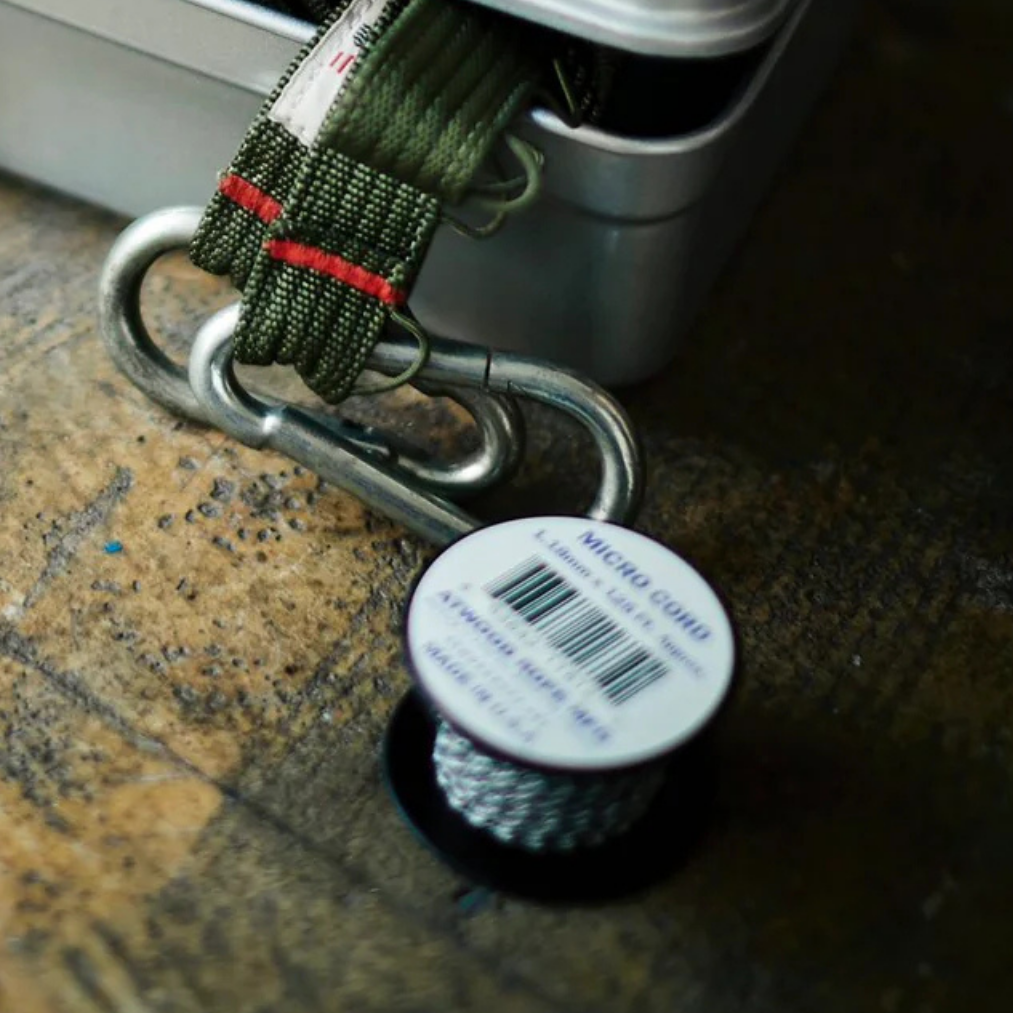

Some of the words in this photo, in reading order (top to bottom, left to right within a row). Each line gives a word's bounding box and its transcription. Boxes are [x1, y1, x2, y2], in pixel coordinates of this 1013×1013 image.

[439, 590, 515, 657] ATWOOD
[577, 530, 650, 589] MICRO
[649, 590, 711, 641] CORD
